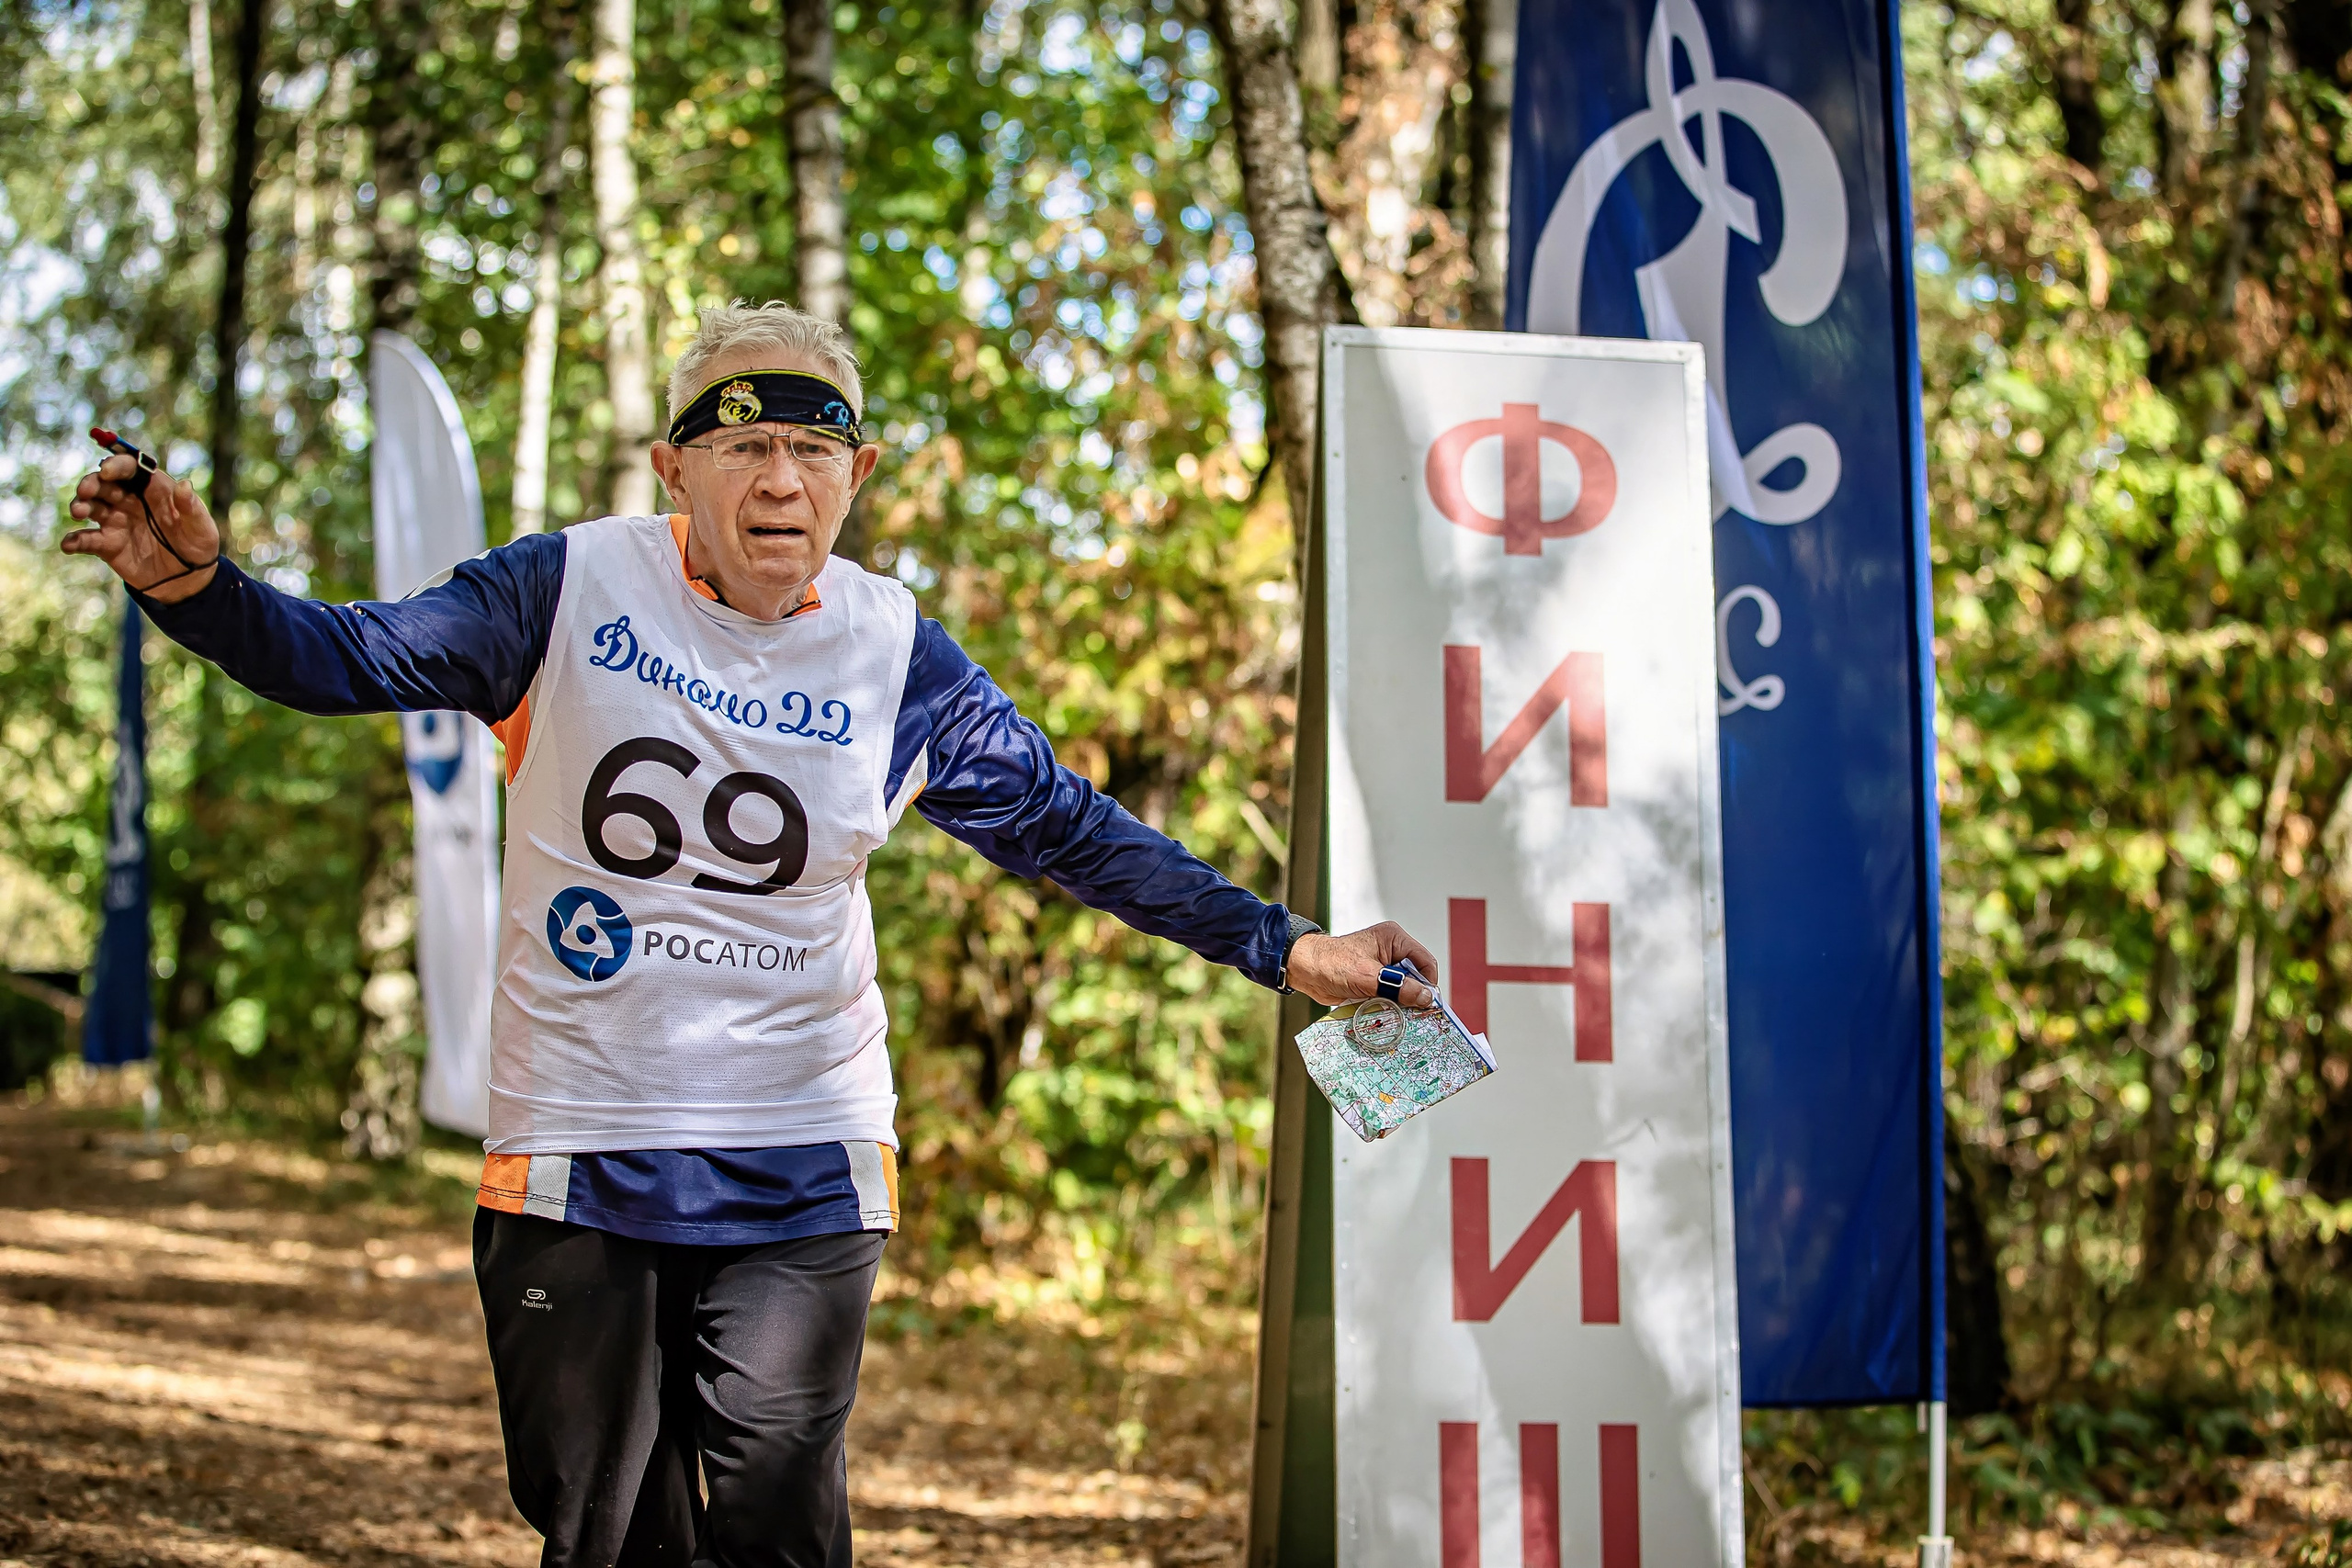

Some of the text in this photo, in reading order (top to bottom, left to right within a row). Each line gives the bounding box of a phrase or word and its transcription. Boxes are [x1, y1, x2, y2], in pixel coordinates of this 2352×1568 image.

[589, 615, 854, 746] Динамо 22
[582, 737, 808, 896] 69
[644, 931, 808, 972] РОСАТОМ
[1425, 402, 1639, 1568] ФИНИШ
[522, 1299, 553, 1311] Kalenji
